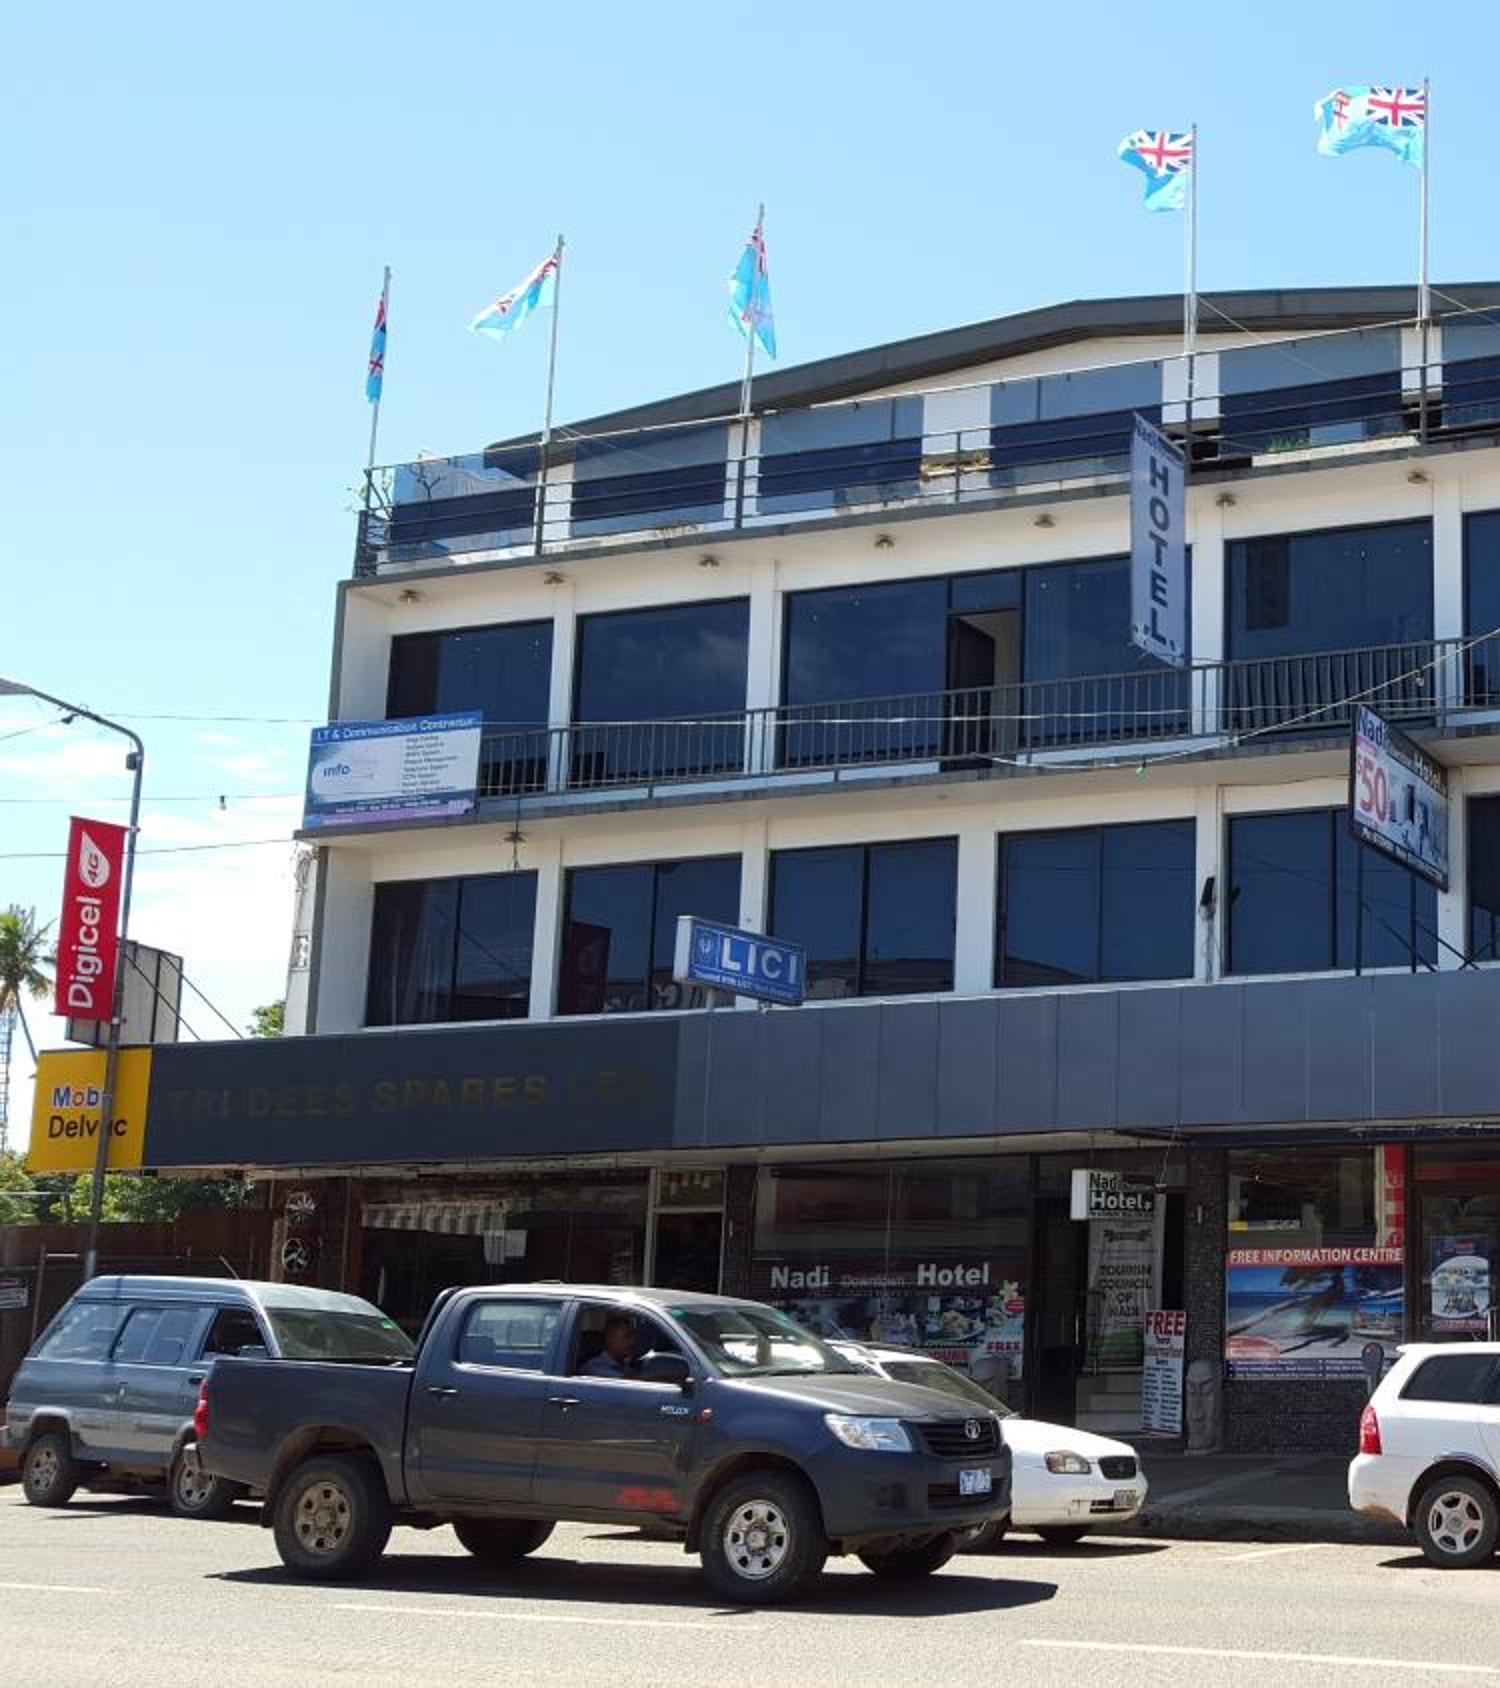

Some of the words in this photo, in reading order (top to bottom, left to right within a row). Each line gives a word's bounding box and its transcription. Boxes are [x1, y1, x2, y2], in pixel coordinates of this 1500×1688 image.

[1149, 456, 1170, 646] HOTEL
[323, 763, 351, 777] info
[68, 896, 102, 1008] Digicel
[722, 938, 797, 984] LICI
[53, 1086, 101, 1107] Mob
[168, 1088, 230, 1120] TRI
[248, 1083, 355, 1121] DEES
[370, 1073, 547, 1113] SPARES
[1091, 1191, 1142, 1210] Hotel
[1231, 1250, 1259, 1264] FREE
[1262, 1248, 1350, 1264] INFORMATION
[1353, 1247, 1405, 1264] CENTRE
[770, 1265, 831, 1289] Nadi
[917, 1262, 990, 1286] Hotel
[1099, 1279, 1153, 1289] COUNCIL
[1117, 1292, 1133, 1303] OF
[1145, 1311, 1185, 1337] FREE
